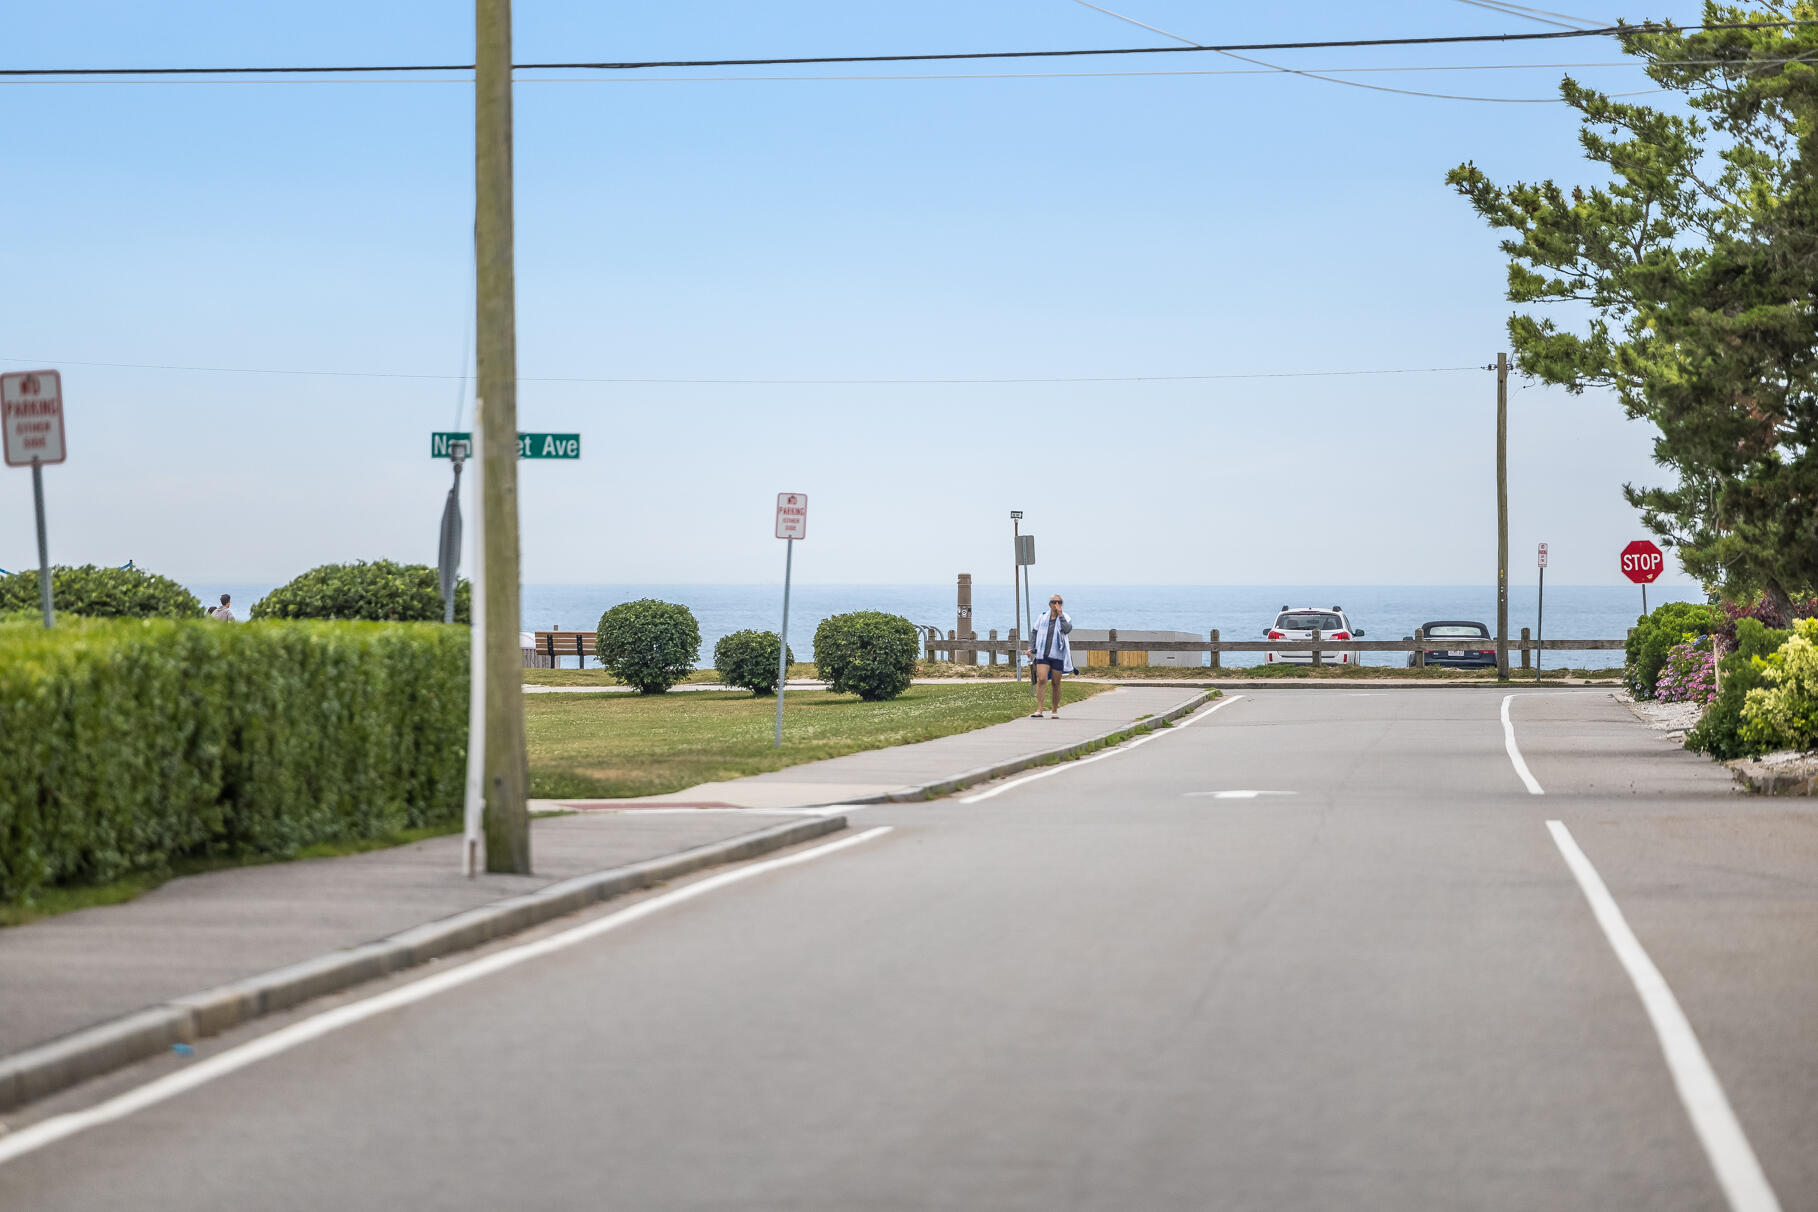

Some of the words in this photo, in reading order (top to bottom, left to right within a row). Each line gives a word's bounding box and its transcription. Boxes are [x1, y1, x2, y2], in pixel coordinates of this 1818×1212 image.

[6, 399, 59, 417] PARKING
[542, 435, 578, 456] Ave
[779, 506, 804, 516] PARKING
[1623, 553, 1661, 571] STOP
